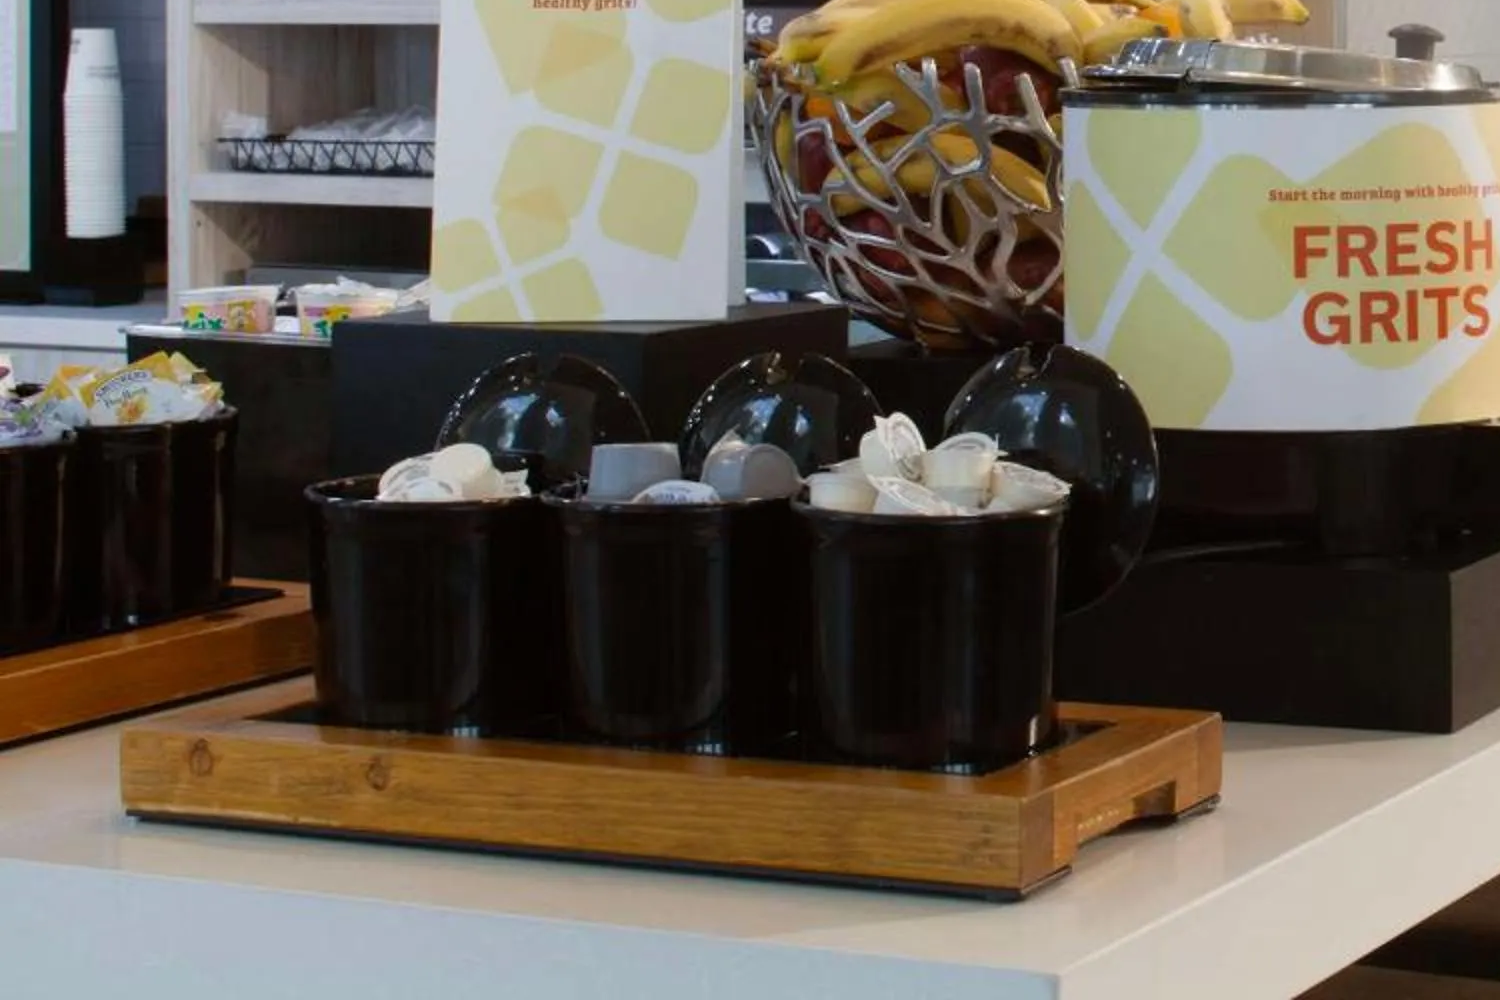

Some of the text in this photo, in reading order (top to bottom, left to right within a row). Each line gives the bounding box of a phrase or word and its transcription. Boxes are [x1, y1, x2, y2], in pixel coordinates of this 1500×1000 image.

[1267, 187, 1309, 202] Start
[1310, 187, 1337, 202] the
[1339, 185, 1402, 204] morning
[1403, 184, 1435, 199] with
[1437, 183, 1479, 199] healthy
[1291, 218, 1494, 280] FRESH
[1301, 283, 1491, 346] GRITS
